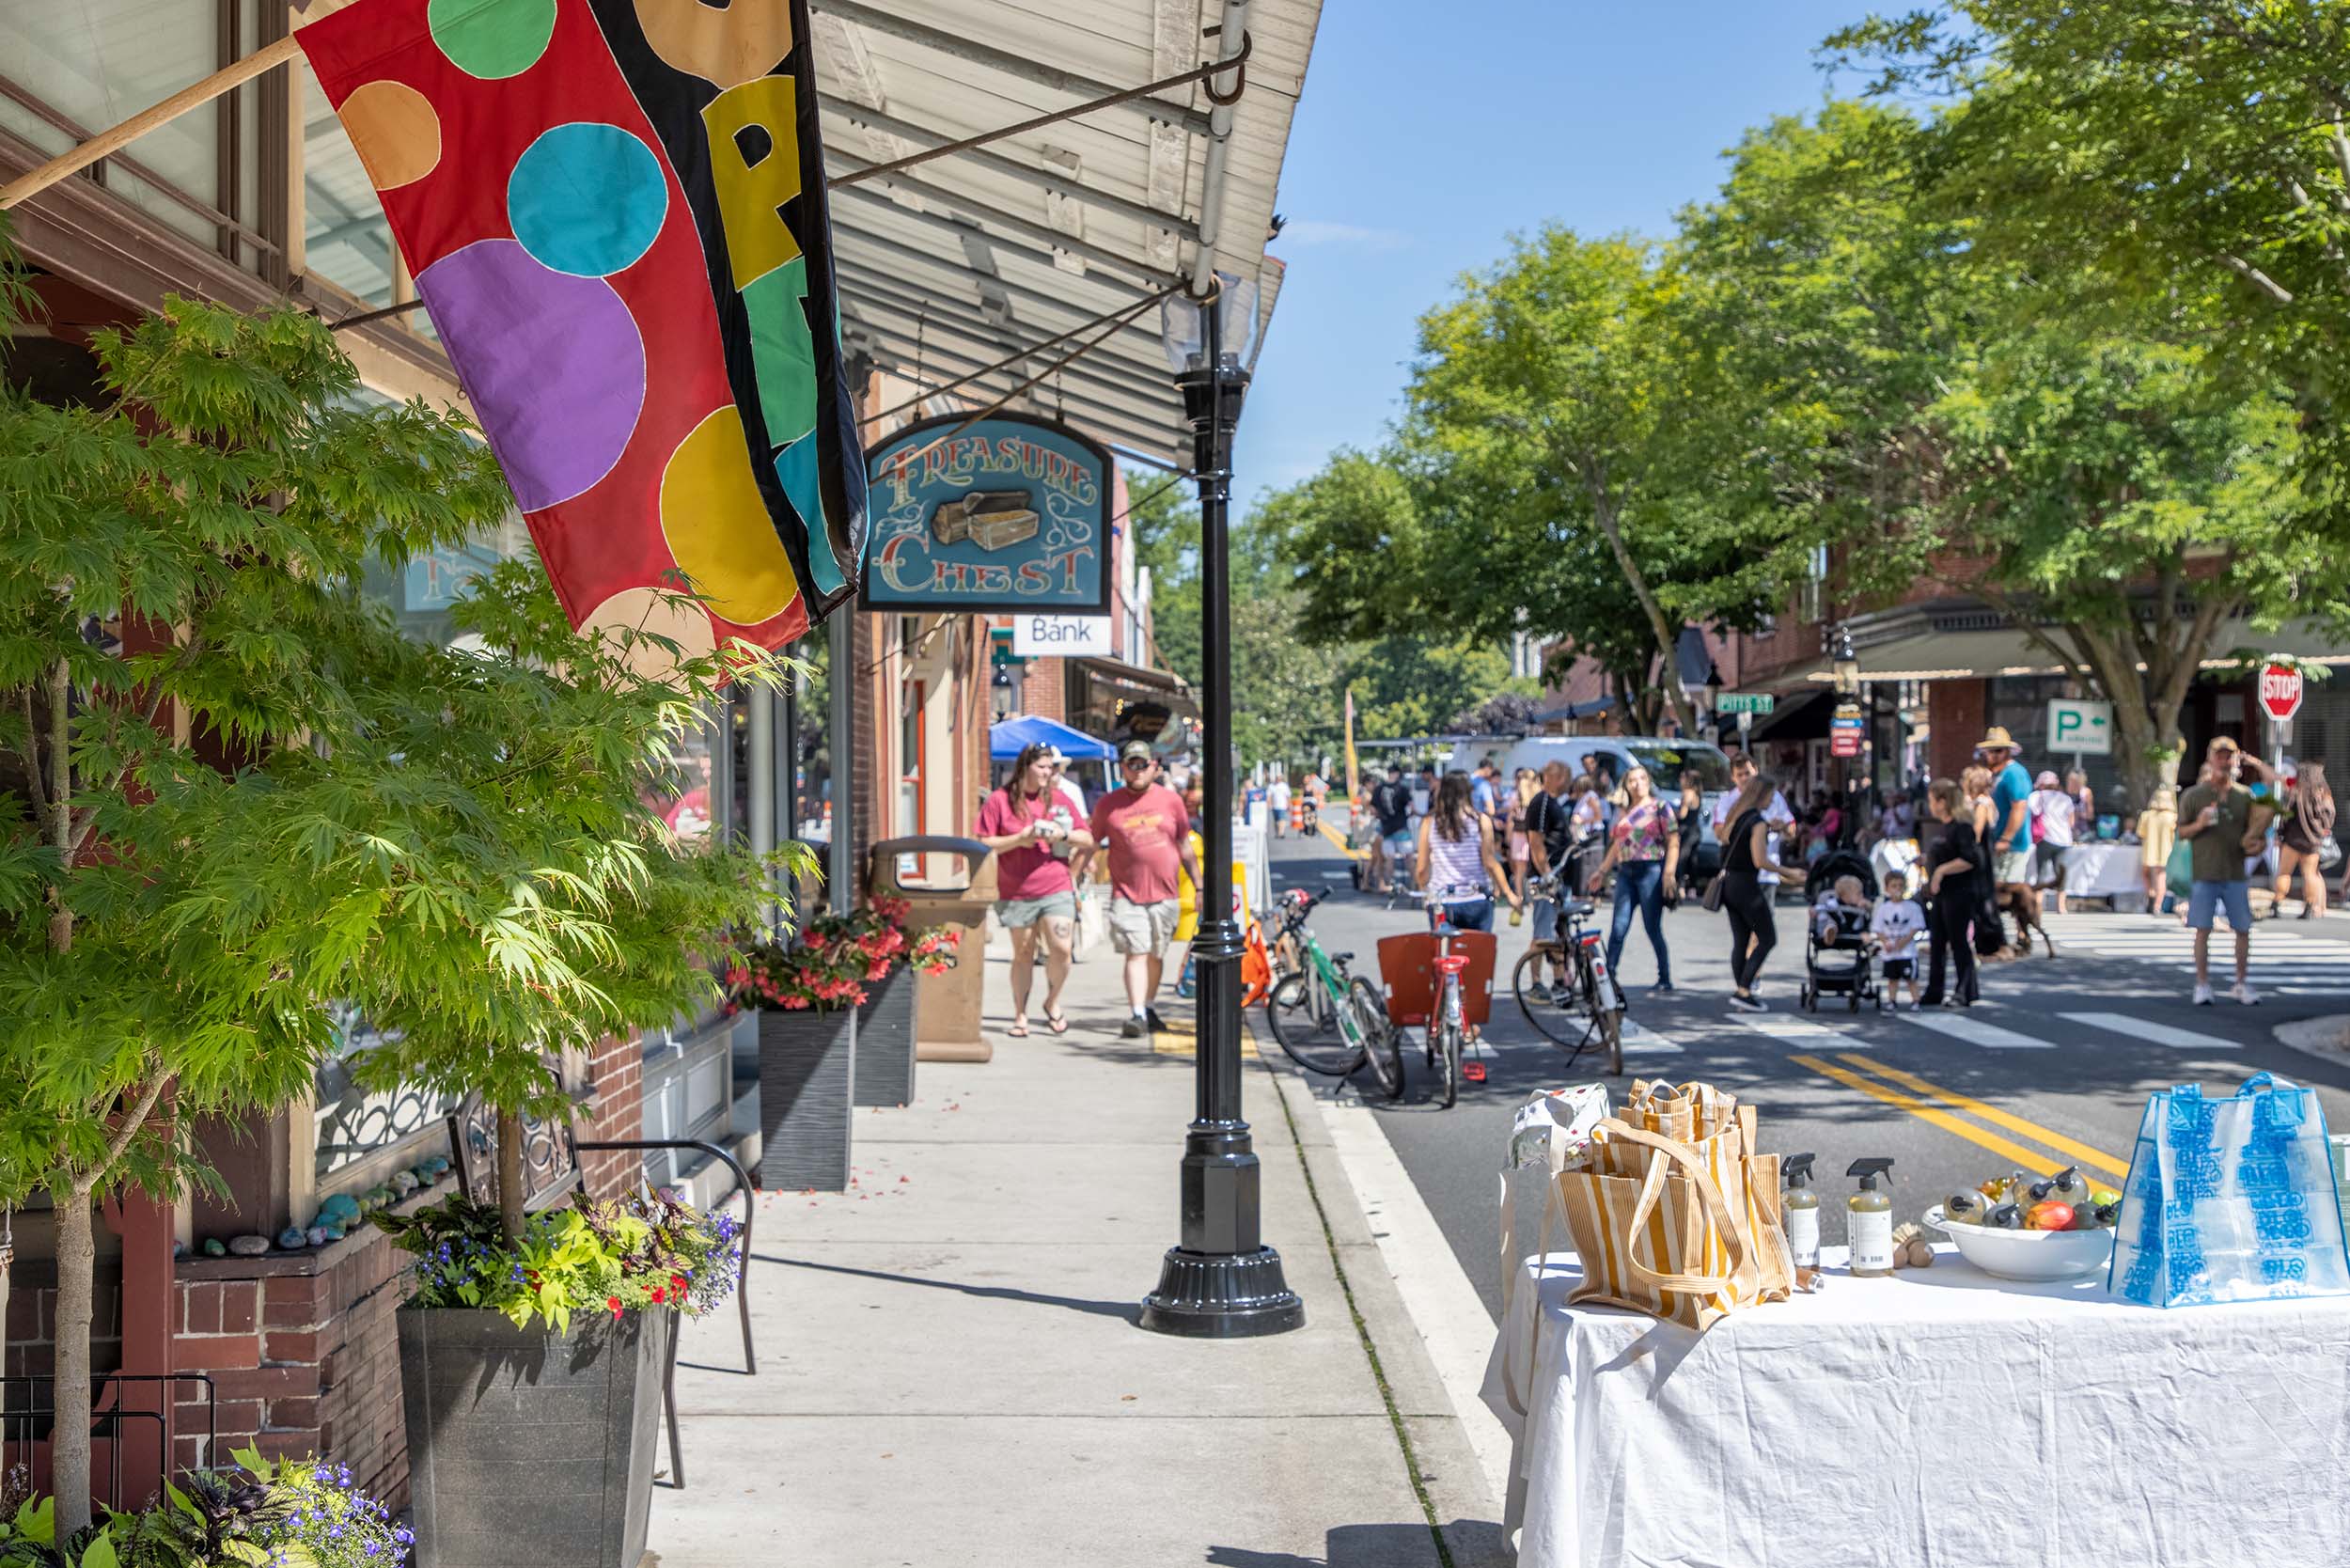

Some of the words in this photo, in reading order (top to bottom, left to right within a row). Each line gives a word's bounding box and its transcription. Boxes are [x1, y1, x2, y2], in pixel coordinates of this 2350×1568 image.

[879, 435, 1098, 513] TREASURE
[871, 530, 1095, 595] CHEST
[1031, 618, 1092, 641] Bank
[2264, 674, 2299, 700] STOP
[2058, 710, 2082, 743] P
